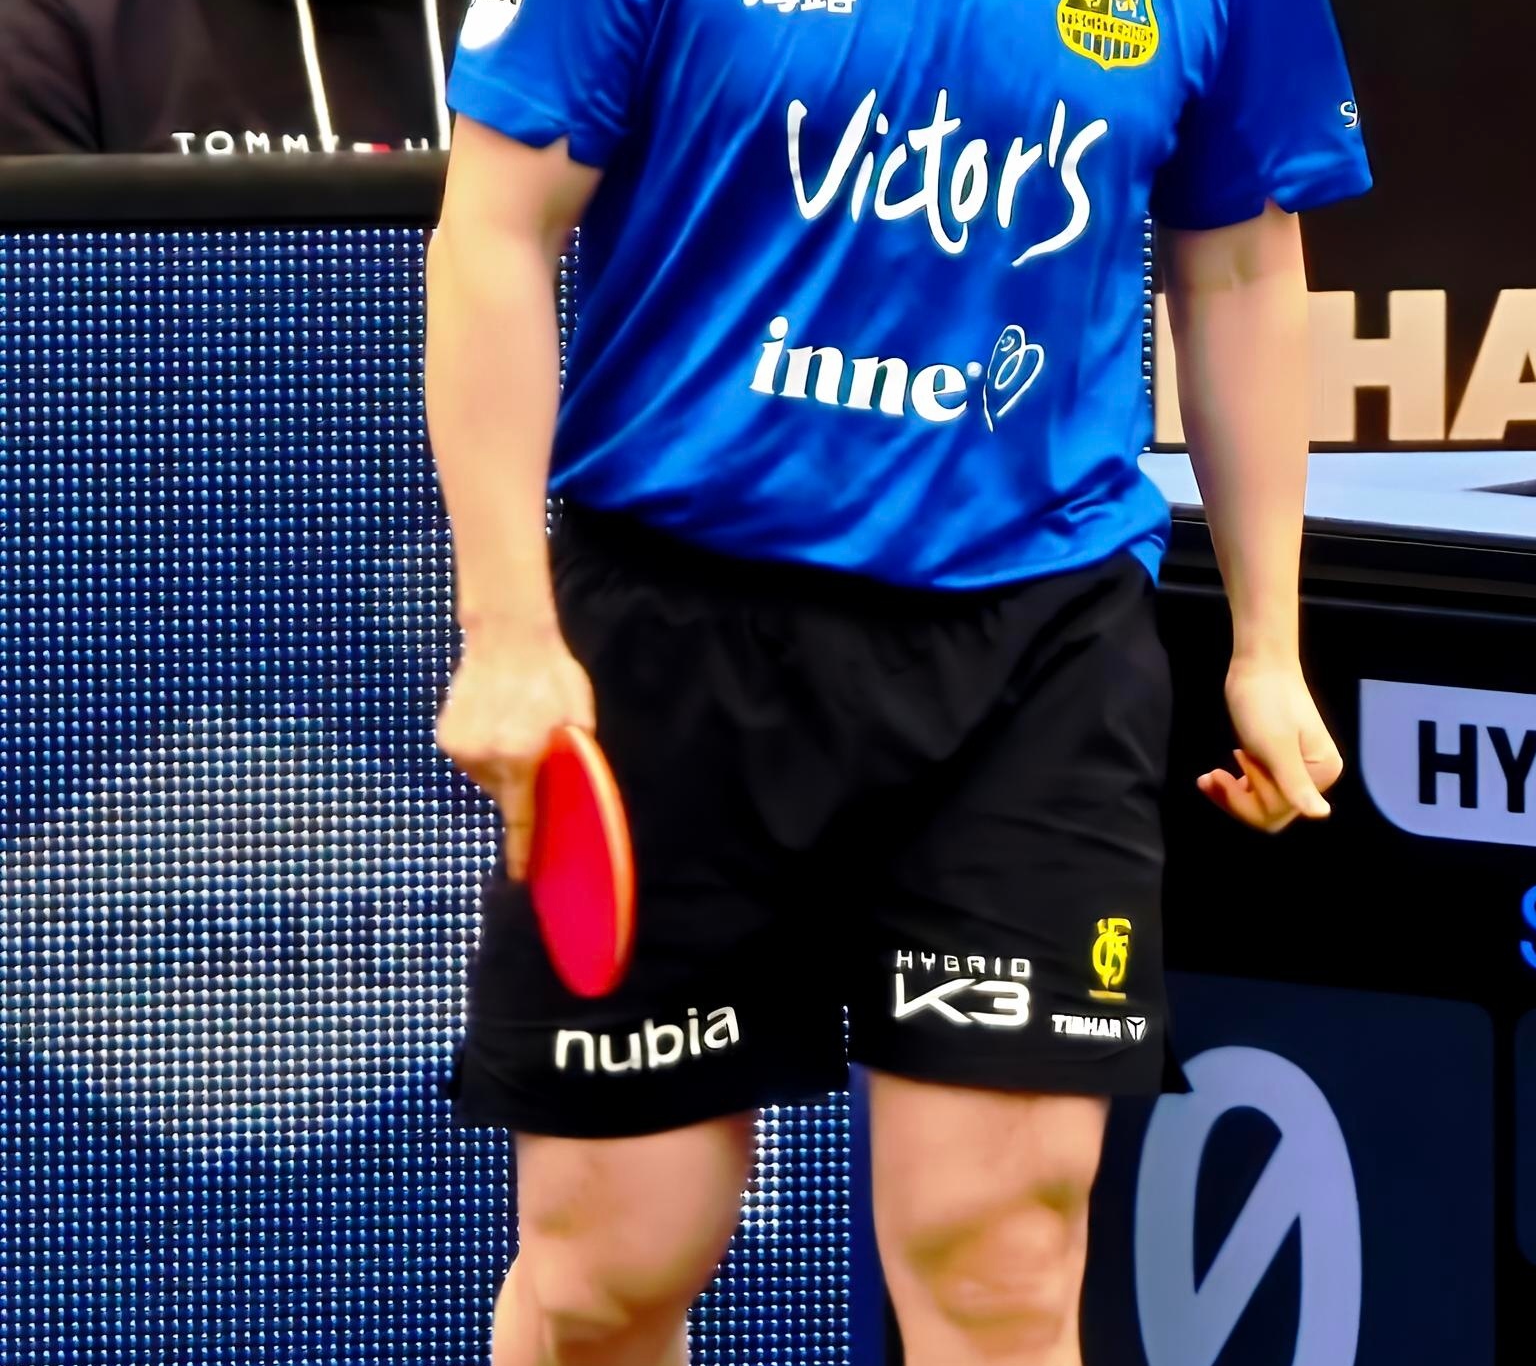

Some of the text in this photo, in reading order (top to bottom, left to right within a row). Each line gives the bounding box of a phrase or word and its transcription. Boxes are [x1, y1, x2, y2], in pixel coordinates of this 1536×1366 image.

[786, 88, 1108, 268] Victor's
[896, 950, 1032, 978] HYBRID
[894, 973, 1032, 1027] K3
[555, 1006, 741, 1073] nubia
